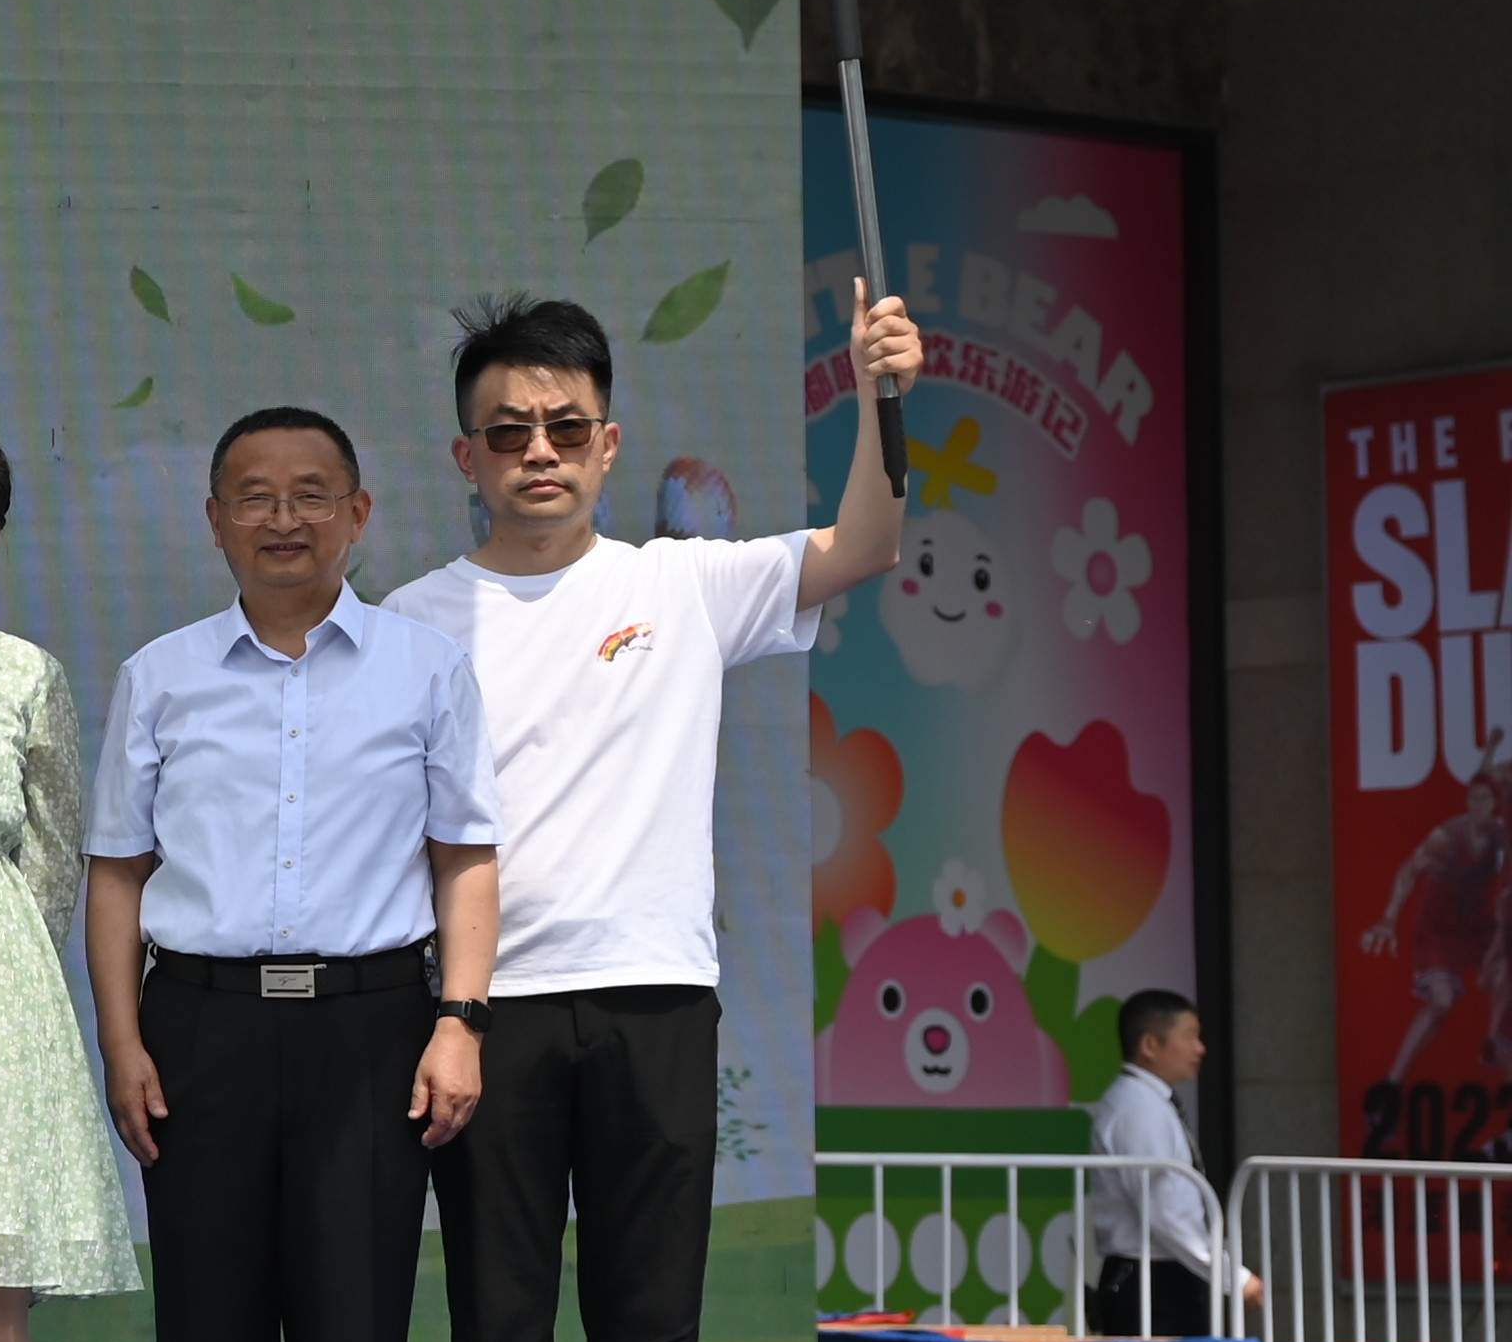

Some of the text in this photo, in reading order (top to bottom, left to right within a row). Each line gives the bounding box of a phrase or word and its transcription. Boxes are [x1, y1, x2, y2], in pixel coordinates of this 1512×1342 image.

[959, 251, 1155, 447] BEAR
[1347, 415, 1459, 479] THE
[1351, 481, 1512, 643] SL
